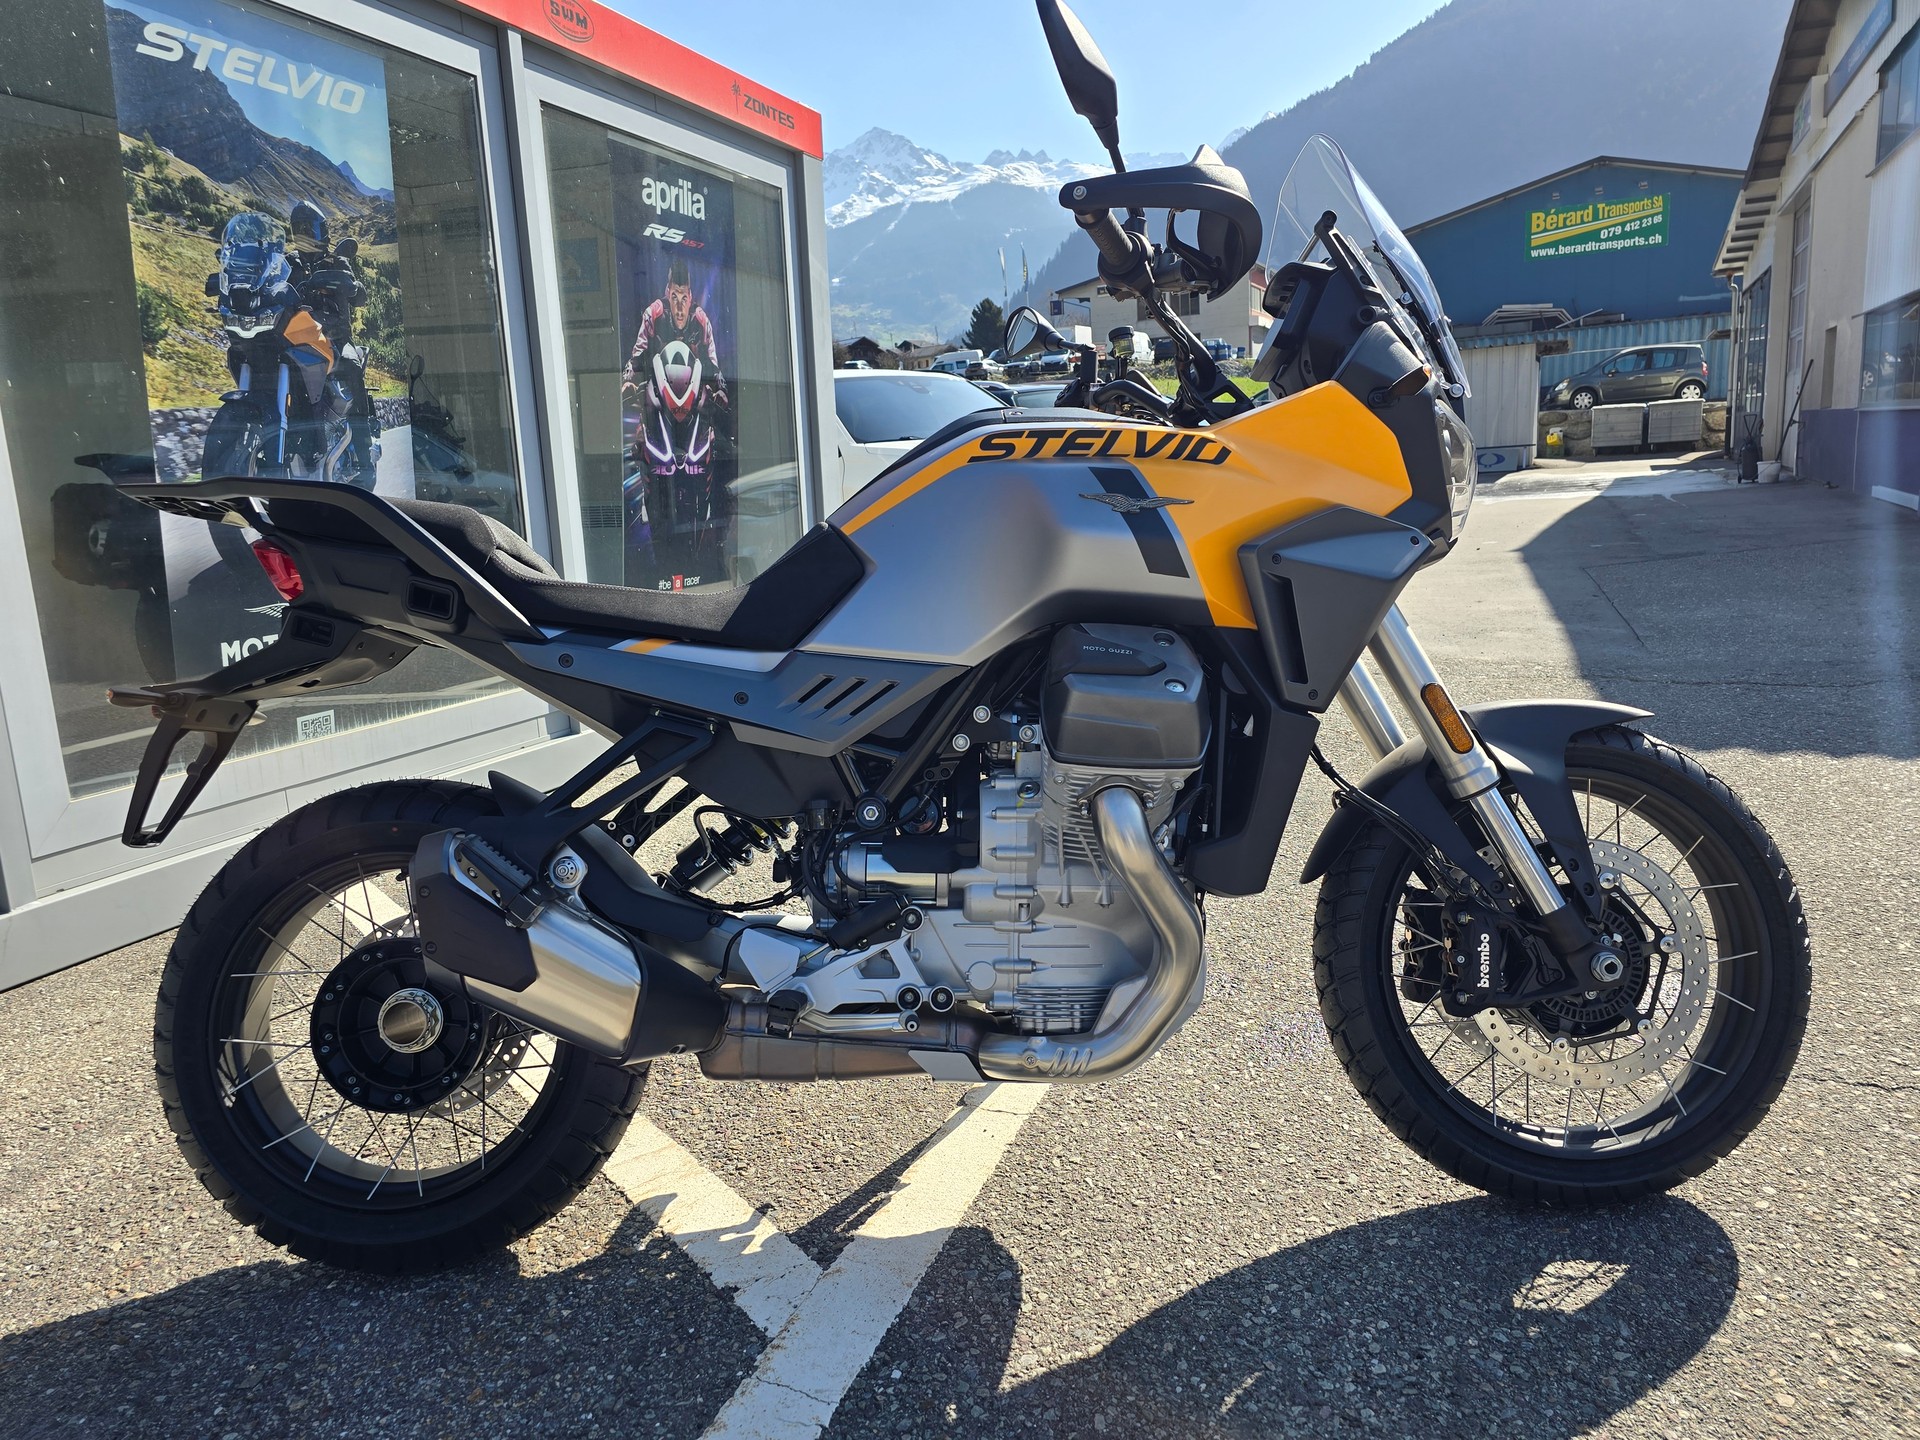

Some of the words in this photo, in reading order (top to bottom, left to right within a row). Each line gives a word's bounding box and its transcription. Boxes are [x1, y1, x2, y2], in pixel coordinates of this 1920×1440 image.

[550, 0, 588, 30] SWM
[136, 22, 366, 114] STELVIO
[743, 93, 795, 130] ZONTES
[642, 177, 705, 220] aprilia
[1531, 205, 1593, 233] Bérard
[1598, 198, 1652, 219] Transports
[1653, 195, 1663, 209] SA
[1531, 233, 1662, 258] www.berardtransports.ch
[1600, 226, 1622, 239] 079
[1624, 220, 1640, 232] 412
[1642, 217, 1652, 227] 23
[967, 429, 1232, 465] STELVIO
[684, 576, 700, 586] racer
[220, 633, 279, 668] MOT
[1477, 933, 1490, 988] brembo
